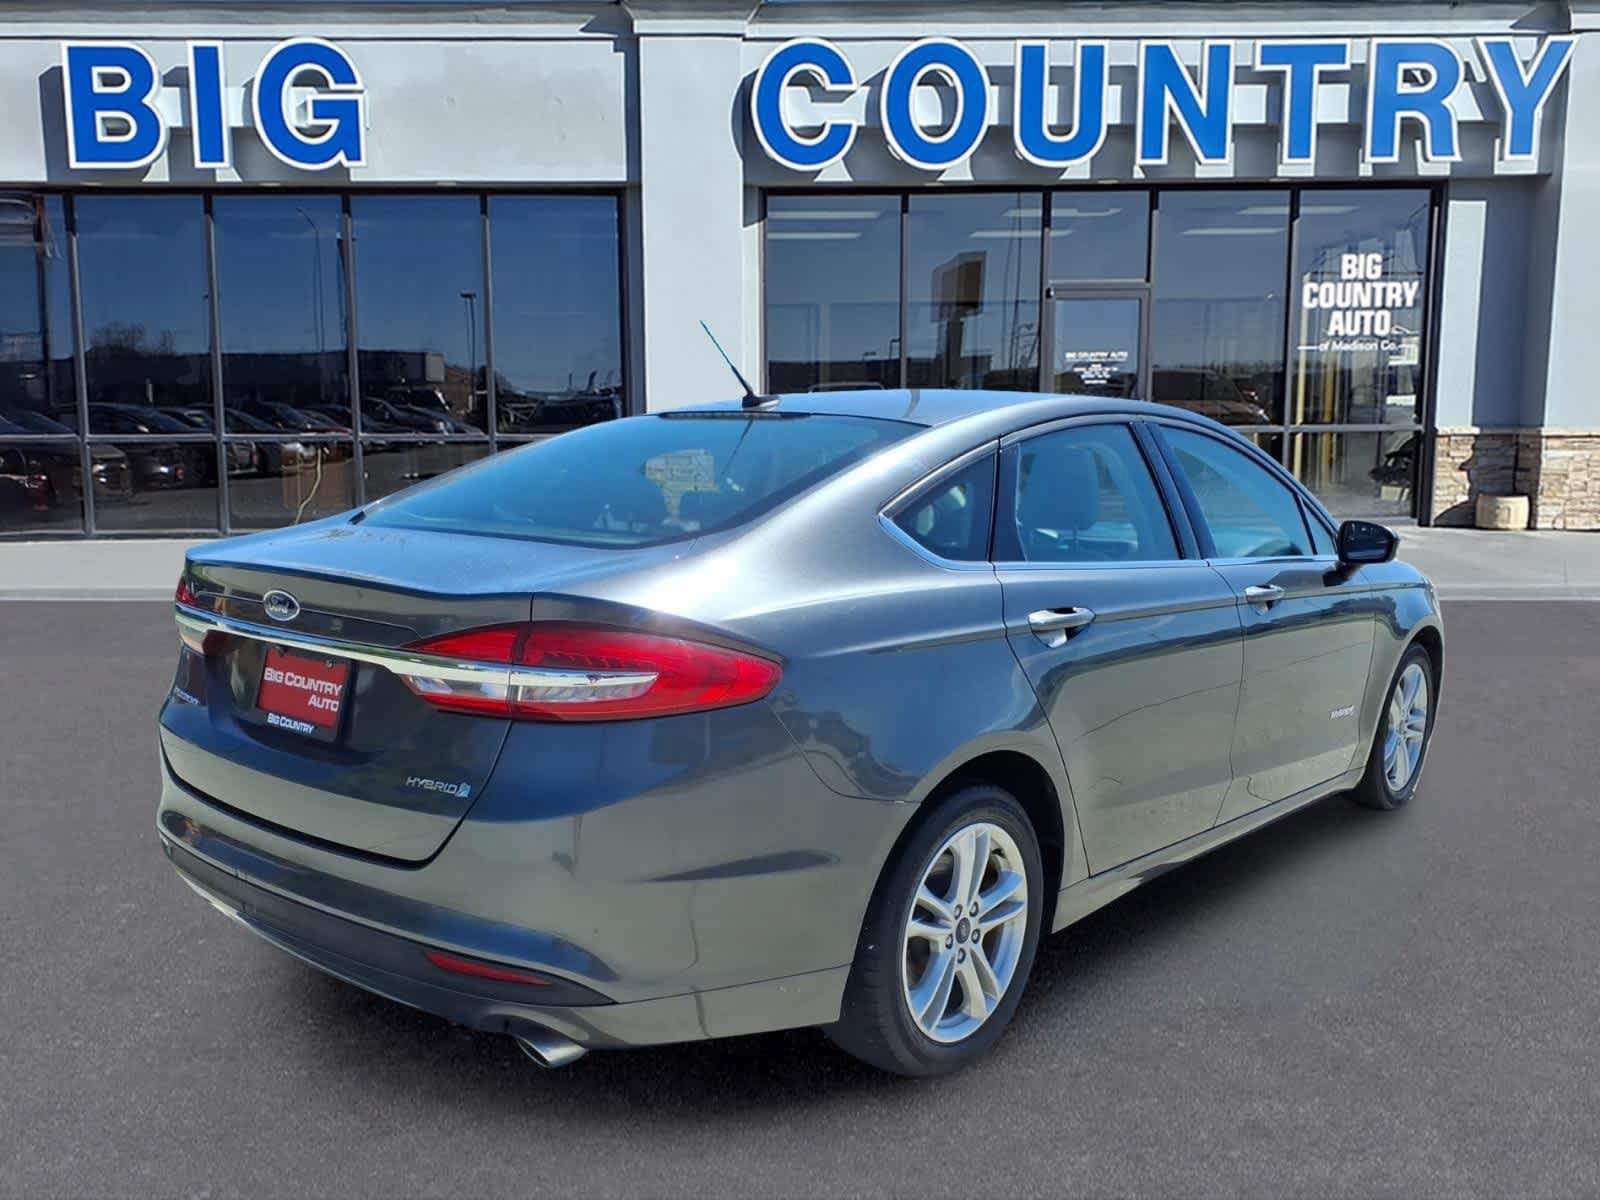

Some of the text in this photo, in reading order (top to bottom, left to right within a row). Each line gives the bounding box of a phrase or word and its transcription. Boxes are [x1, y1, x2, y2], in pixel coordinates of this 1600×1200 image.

[61, 36, 1576, 171] BIG COUNTRY
[1341, 253, 1382, 280] BIG
[1302, 281, 1419, 309] COUNTRY
[1328, 309, 1391, 336] AUTO
[1319, 339, 1399, 351] of Madison Co.
[263, 667, 342, 696] BIG COUNTRY
[308, 694, 340, 713] AUTO
[267, 712, 315, 735] BIG COUNTRY
[405, 776, 458, 794] HYBRID
